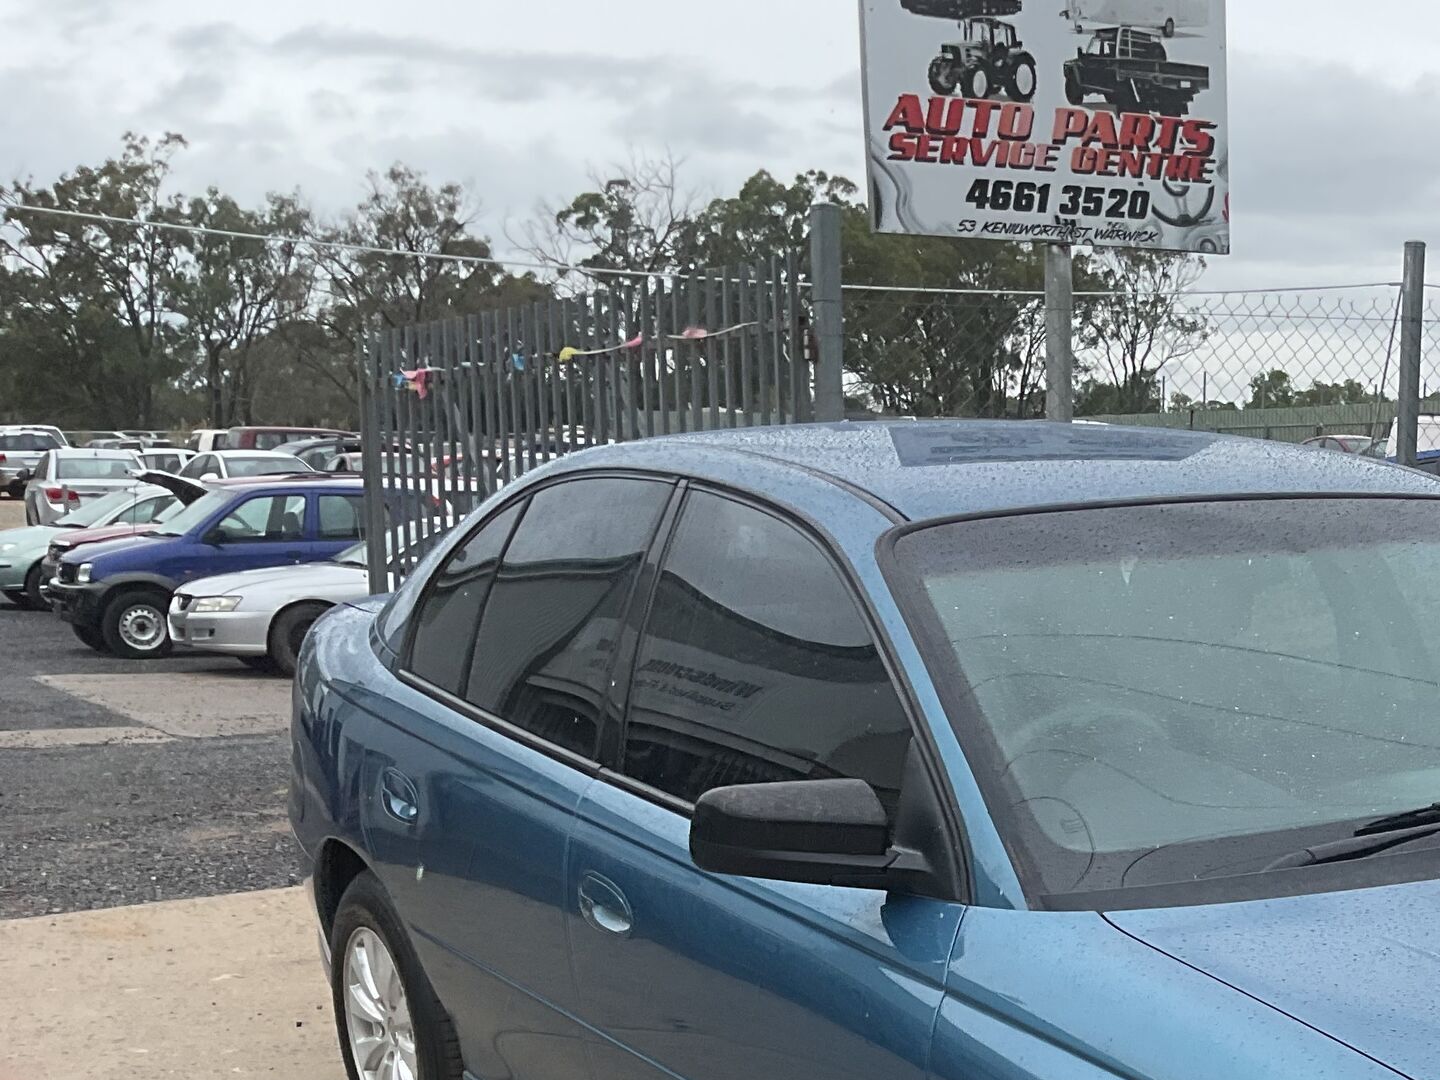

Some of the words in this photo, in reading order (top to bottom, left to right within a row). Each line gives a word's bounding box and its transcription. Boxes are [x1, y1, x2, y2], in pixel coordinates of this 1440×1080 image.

[883, 94, 1035, 142] AUTO
[1052, 107, 1218, 159] PARTS
[887, 132, 1060, 172] SERVICE
[1070, 146, 1216, 184] CENTRE
[965, 178, 1051, 214] 4661
[1059, 184, 1150, 220] 3520
[957, 219, 976, 233] 53
[1094, 228, 1159, 243] WARWICK
